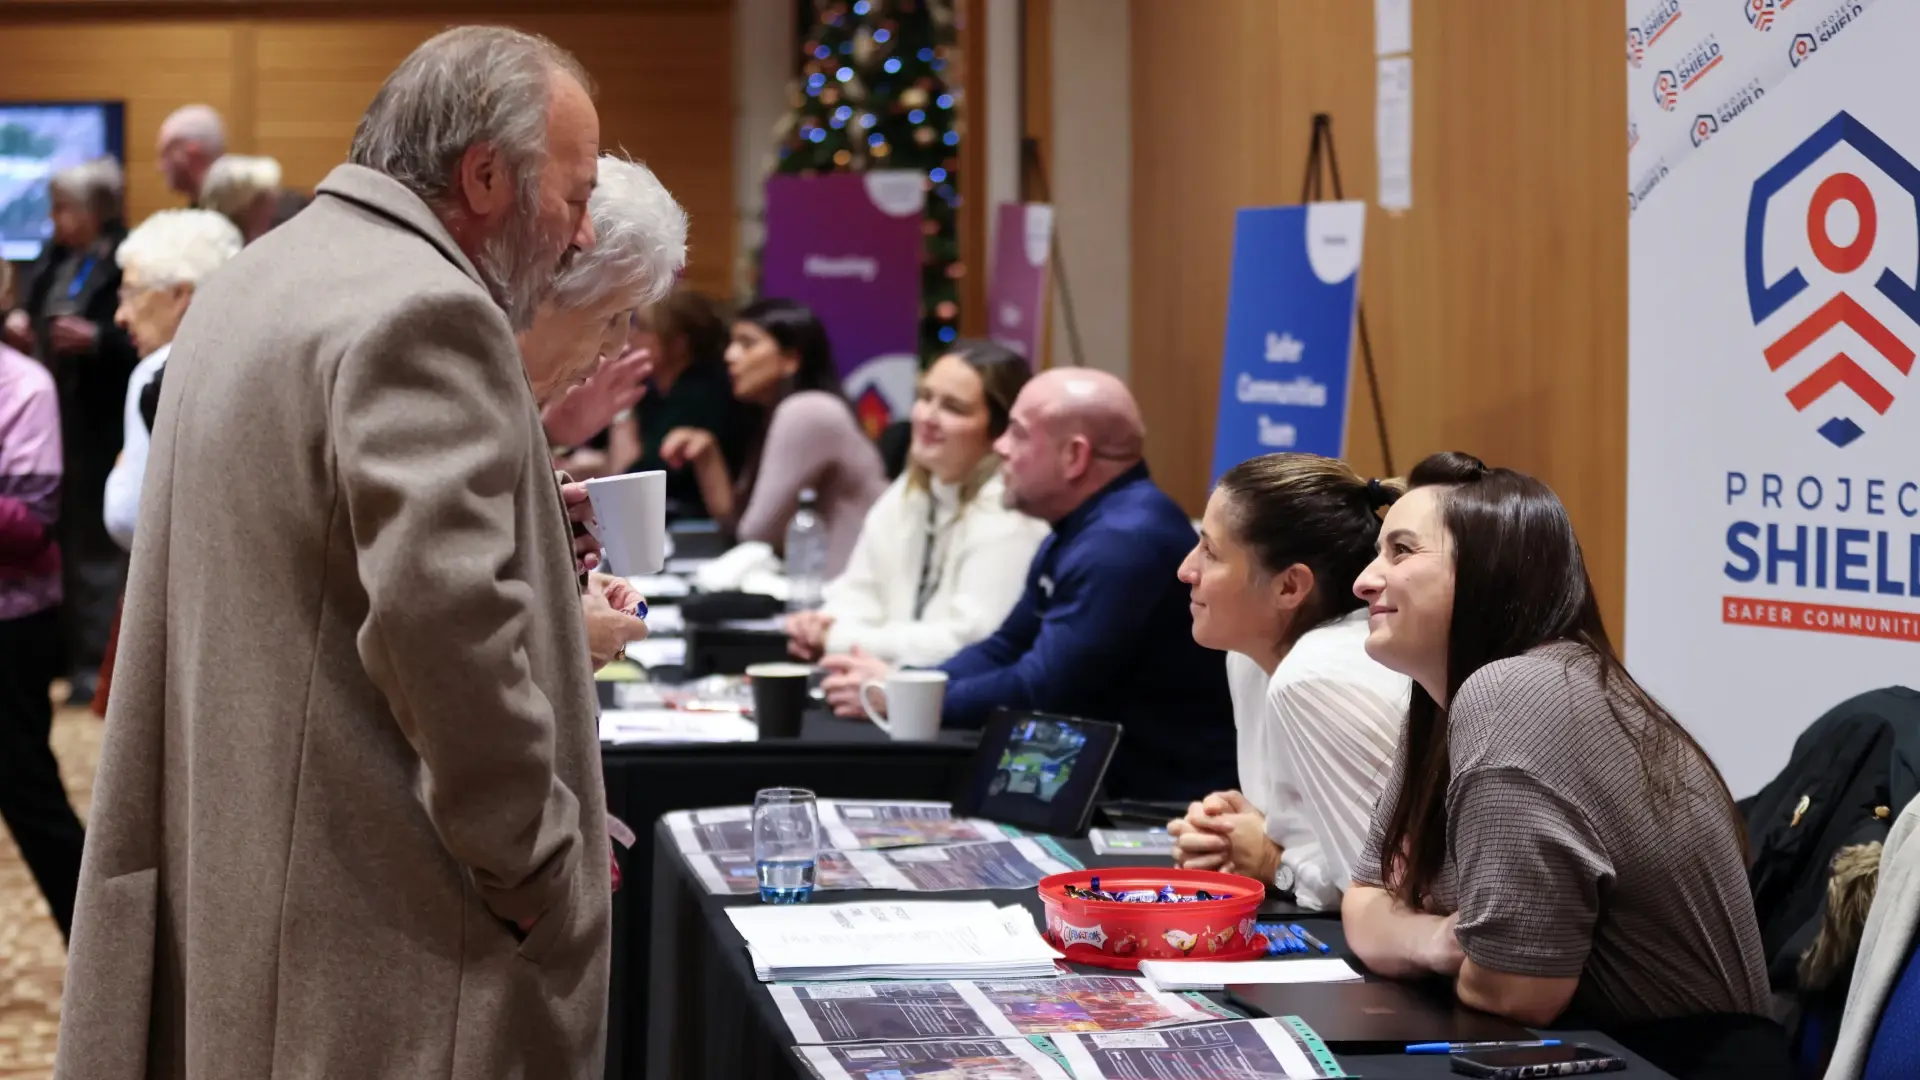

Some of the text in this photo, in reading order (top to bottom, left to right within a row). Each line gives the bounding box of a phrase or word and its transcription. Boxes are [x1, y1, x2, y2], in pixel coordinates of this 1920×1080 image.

[1678, 42, 1719, 83] SHIELD
[1726, 470, 1919, 518] PROJEC
[1727, 602, 1919, 637] SAFER COMMUNITI
